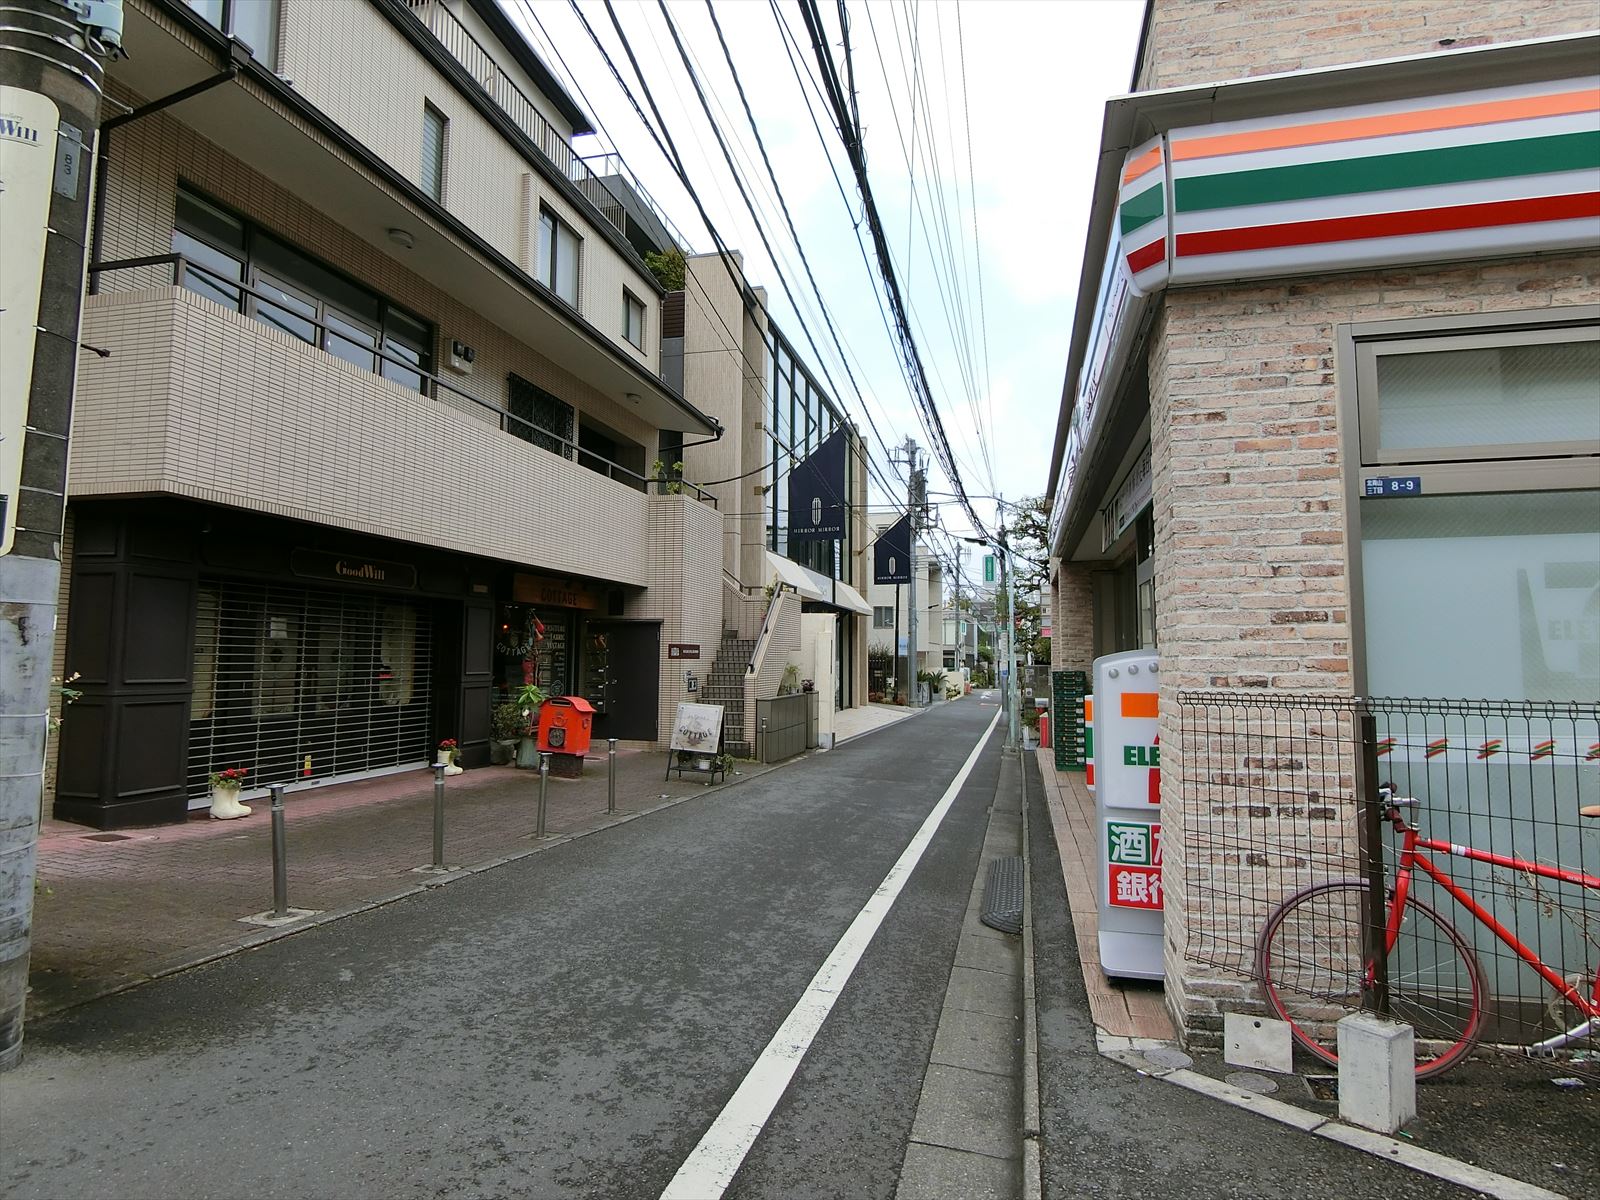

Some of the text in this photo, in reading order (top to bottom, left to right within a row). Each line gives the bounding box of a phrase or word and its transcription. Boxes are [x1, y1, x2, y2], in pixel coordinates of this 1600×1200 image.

[1391, 480, 1414, 491] 8-9
[335, 560, 385, 581] GoodWill
[541, 587, 578, 606] COTTAGE
[496, 641, 532, 656] COTTAGE
[679, 724, 713, 741] COTTAGE
[1111, 824, 1148, 863] 酒
